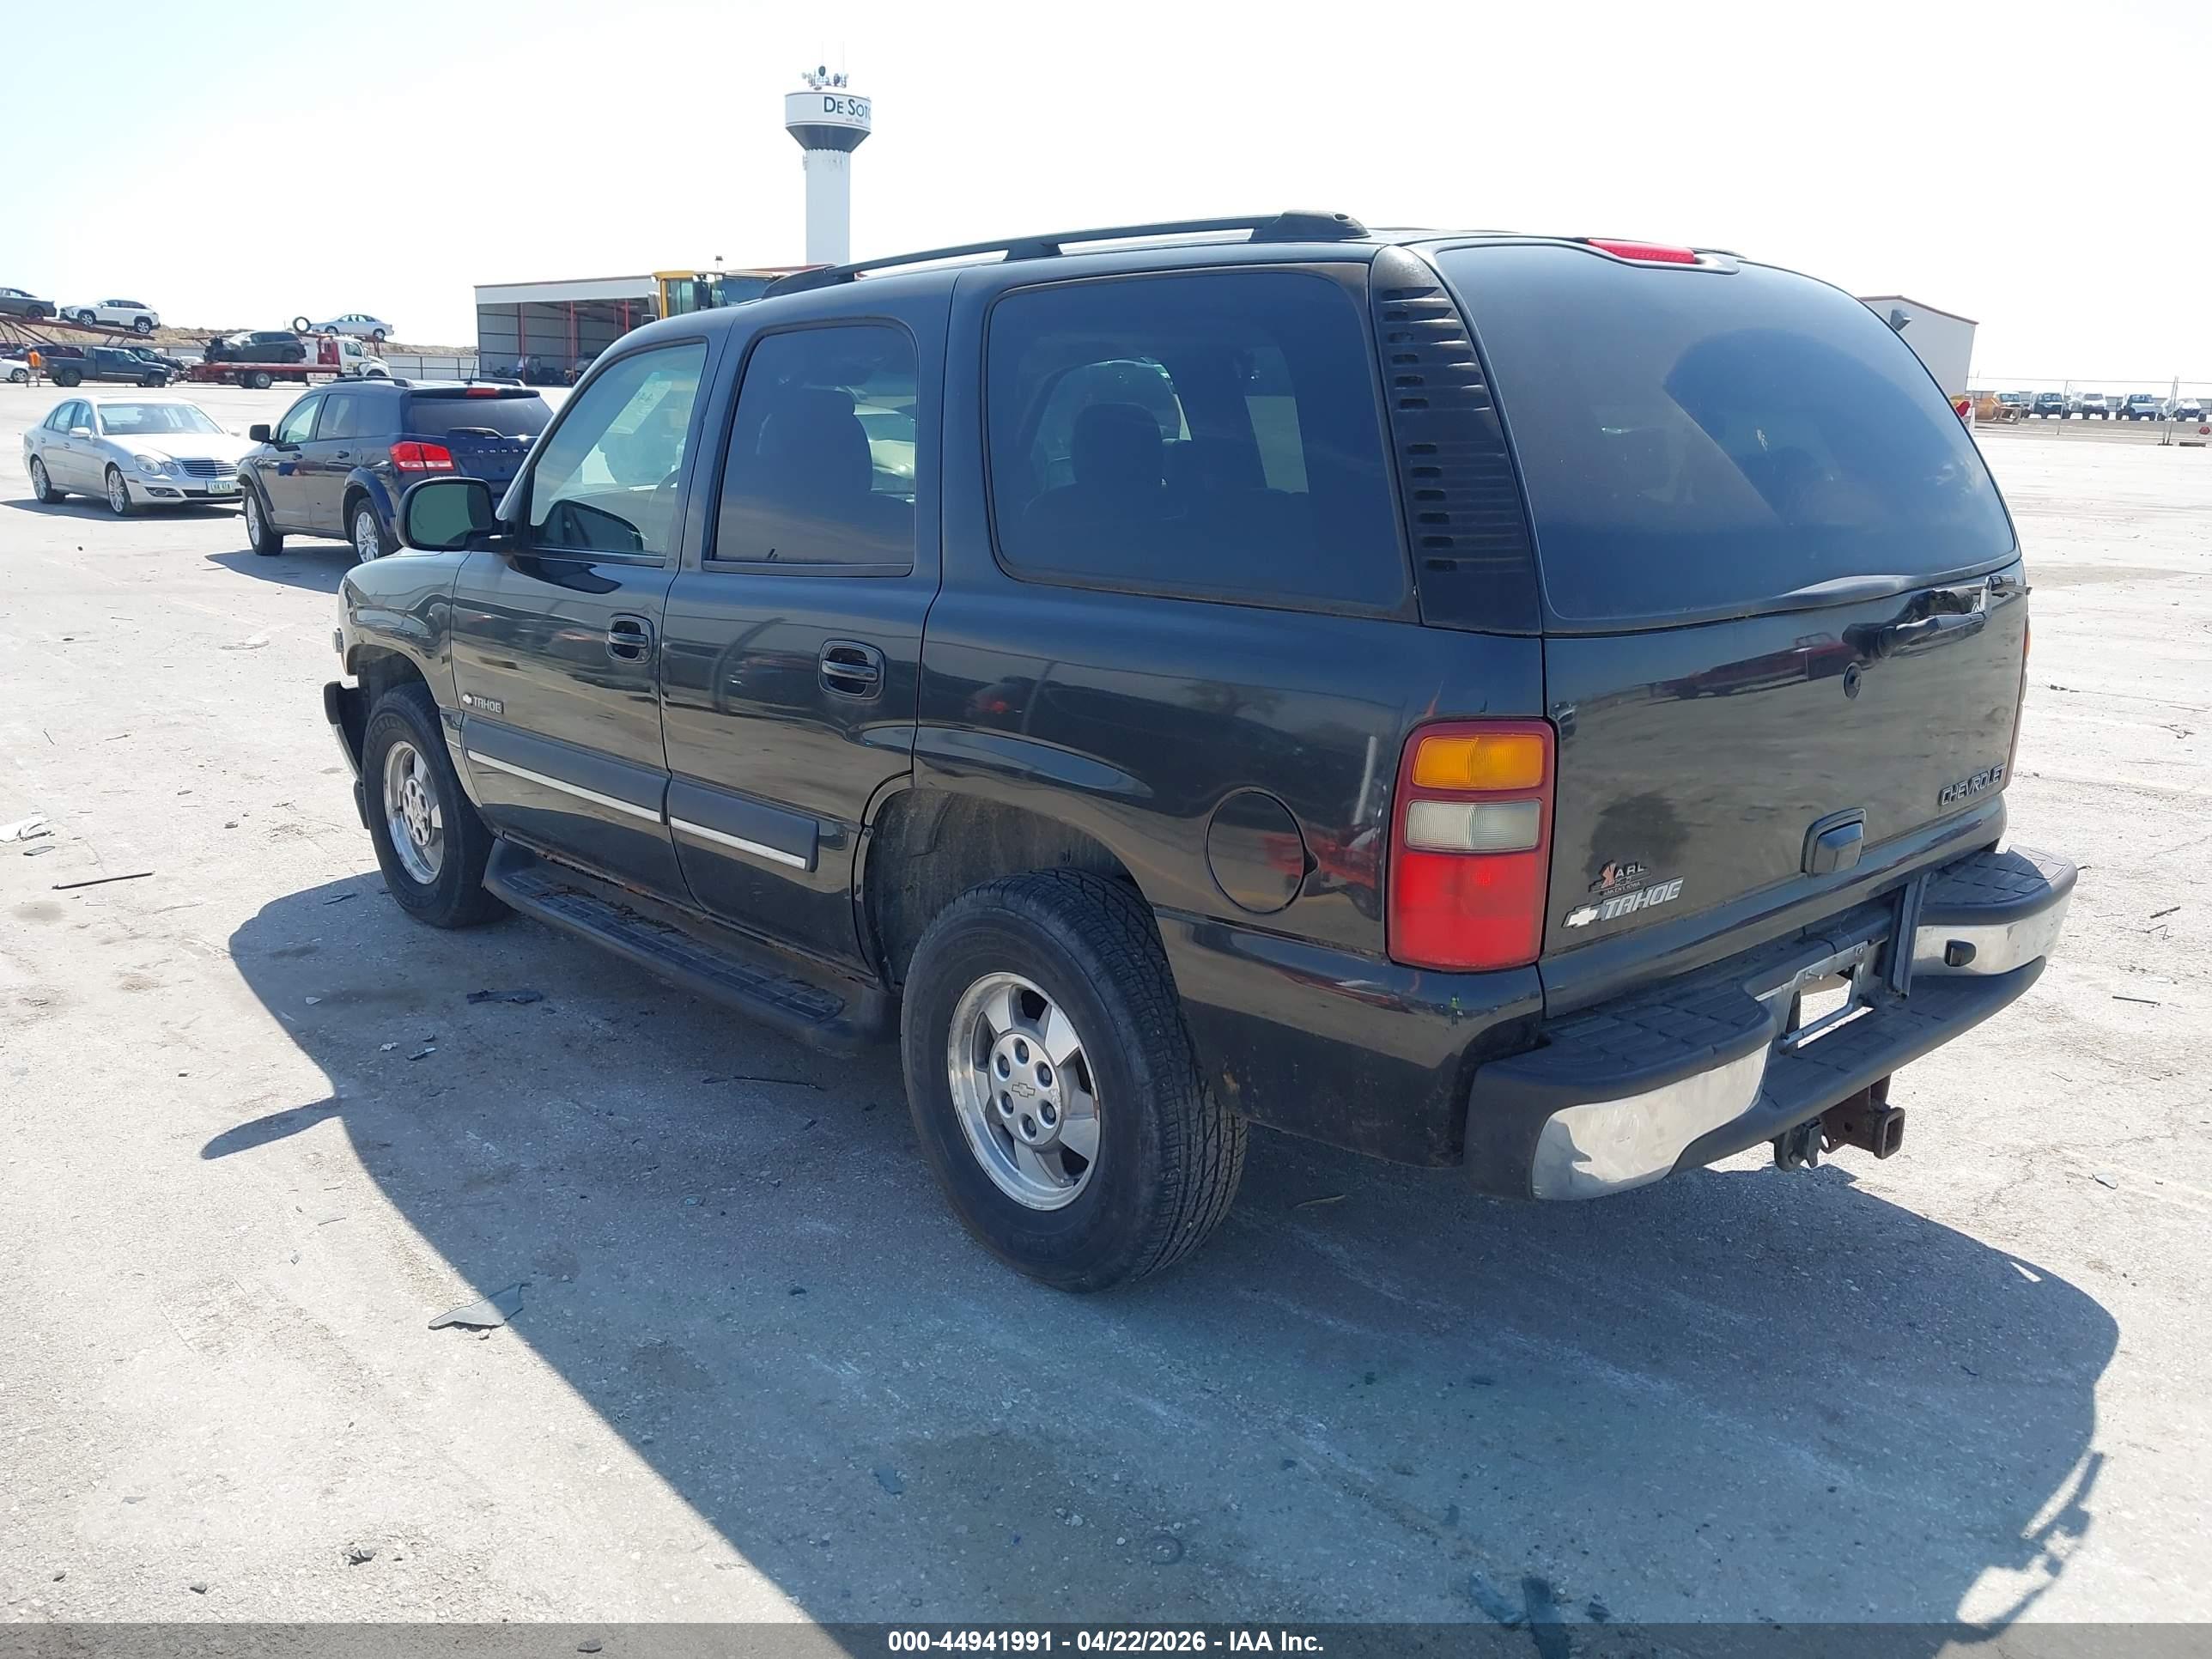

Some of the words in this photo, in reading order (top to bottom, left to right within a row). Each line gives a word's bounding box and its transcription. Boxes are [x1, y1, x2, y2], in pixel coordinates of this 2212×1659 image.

[473, 696, 502, 714] TAHOE
[1941, 765, 2007, 805] CHEVROLET
[1603, 878, 1684, 921] TAHOE
